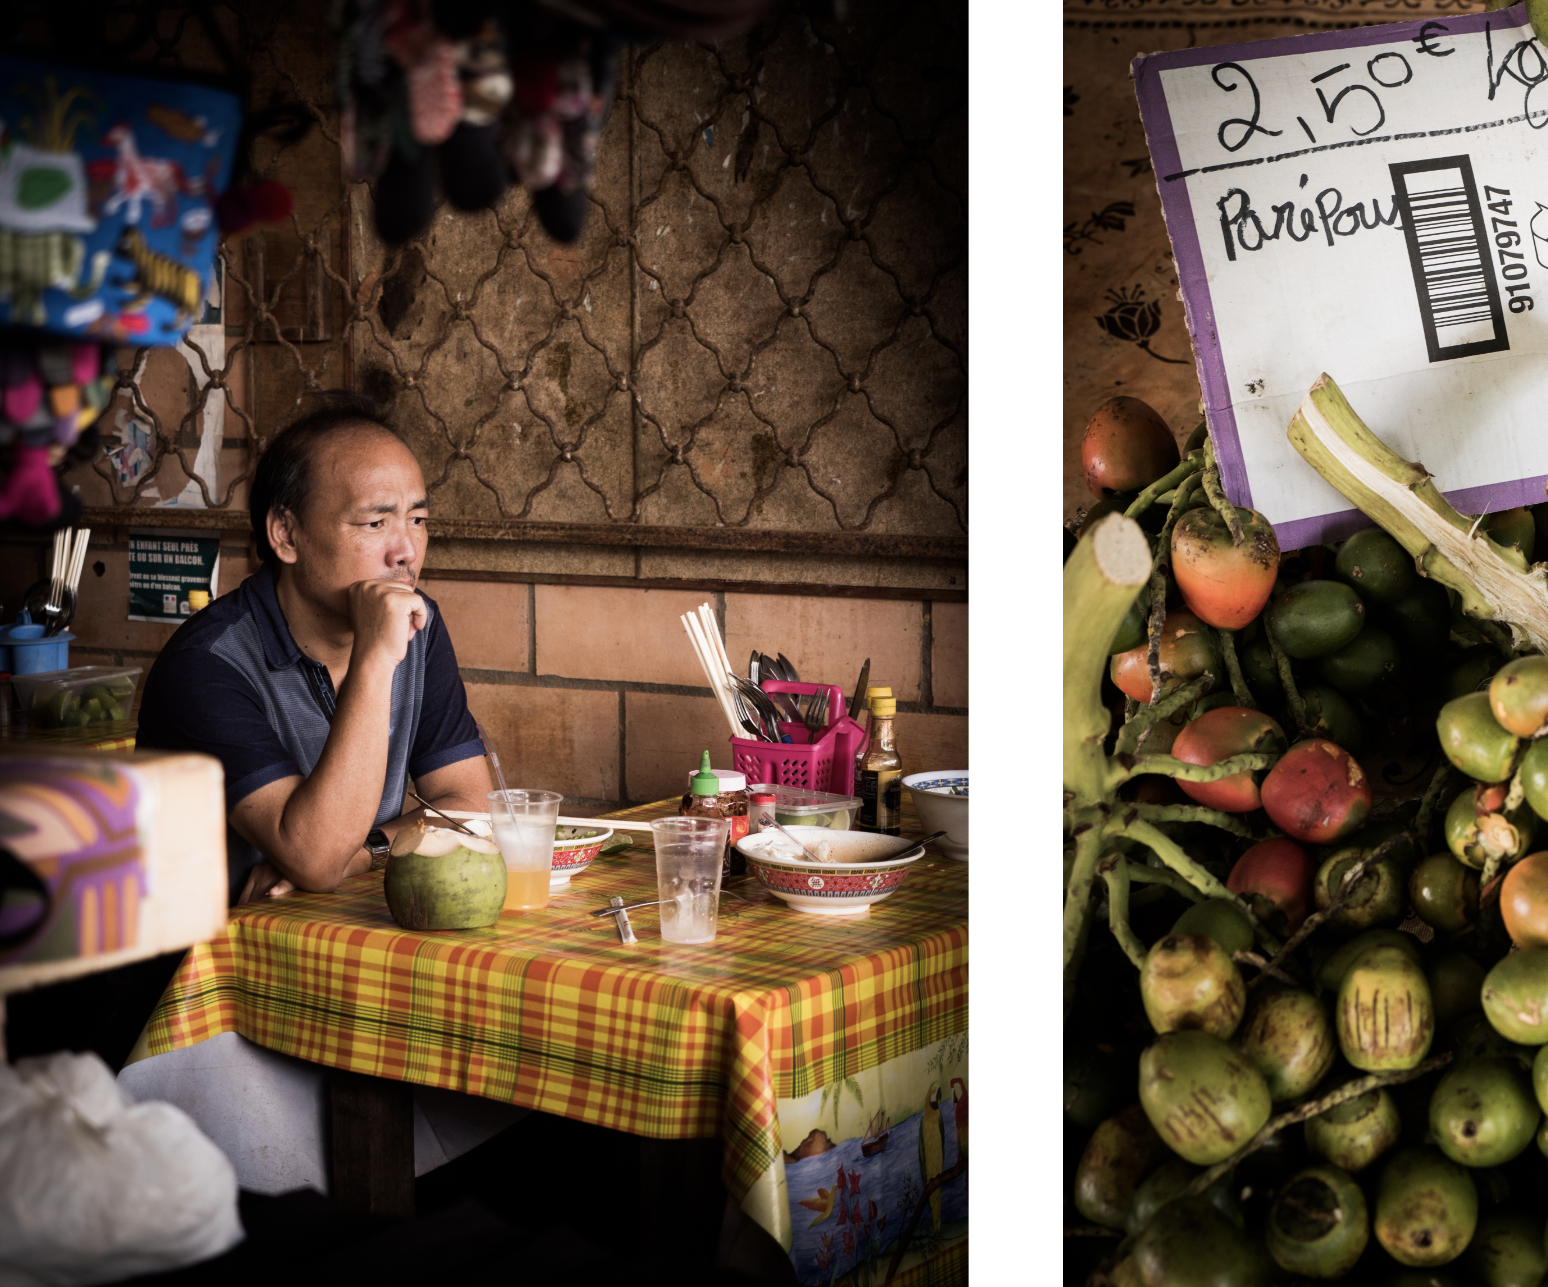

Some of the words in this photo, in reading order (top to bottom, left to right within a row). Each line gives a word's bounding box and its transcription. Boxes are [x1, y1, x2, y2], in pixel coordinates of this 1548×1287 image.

[1483, 185, 1534, 314] 91079747
[136, 541, 161, 551] ENFANT
[163, 542, 179, 552] SEUL
[181, 541, 199, 553] PRÈS
[137, 553, 147, 562] OU
[148, 553, 162, 563] SUR
[164, 554, 173, 564] UN
[175, 554, 204, 566] BALCON.
